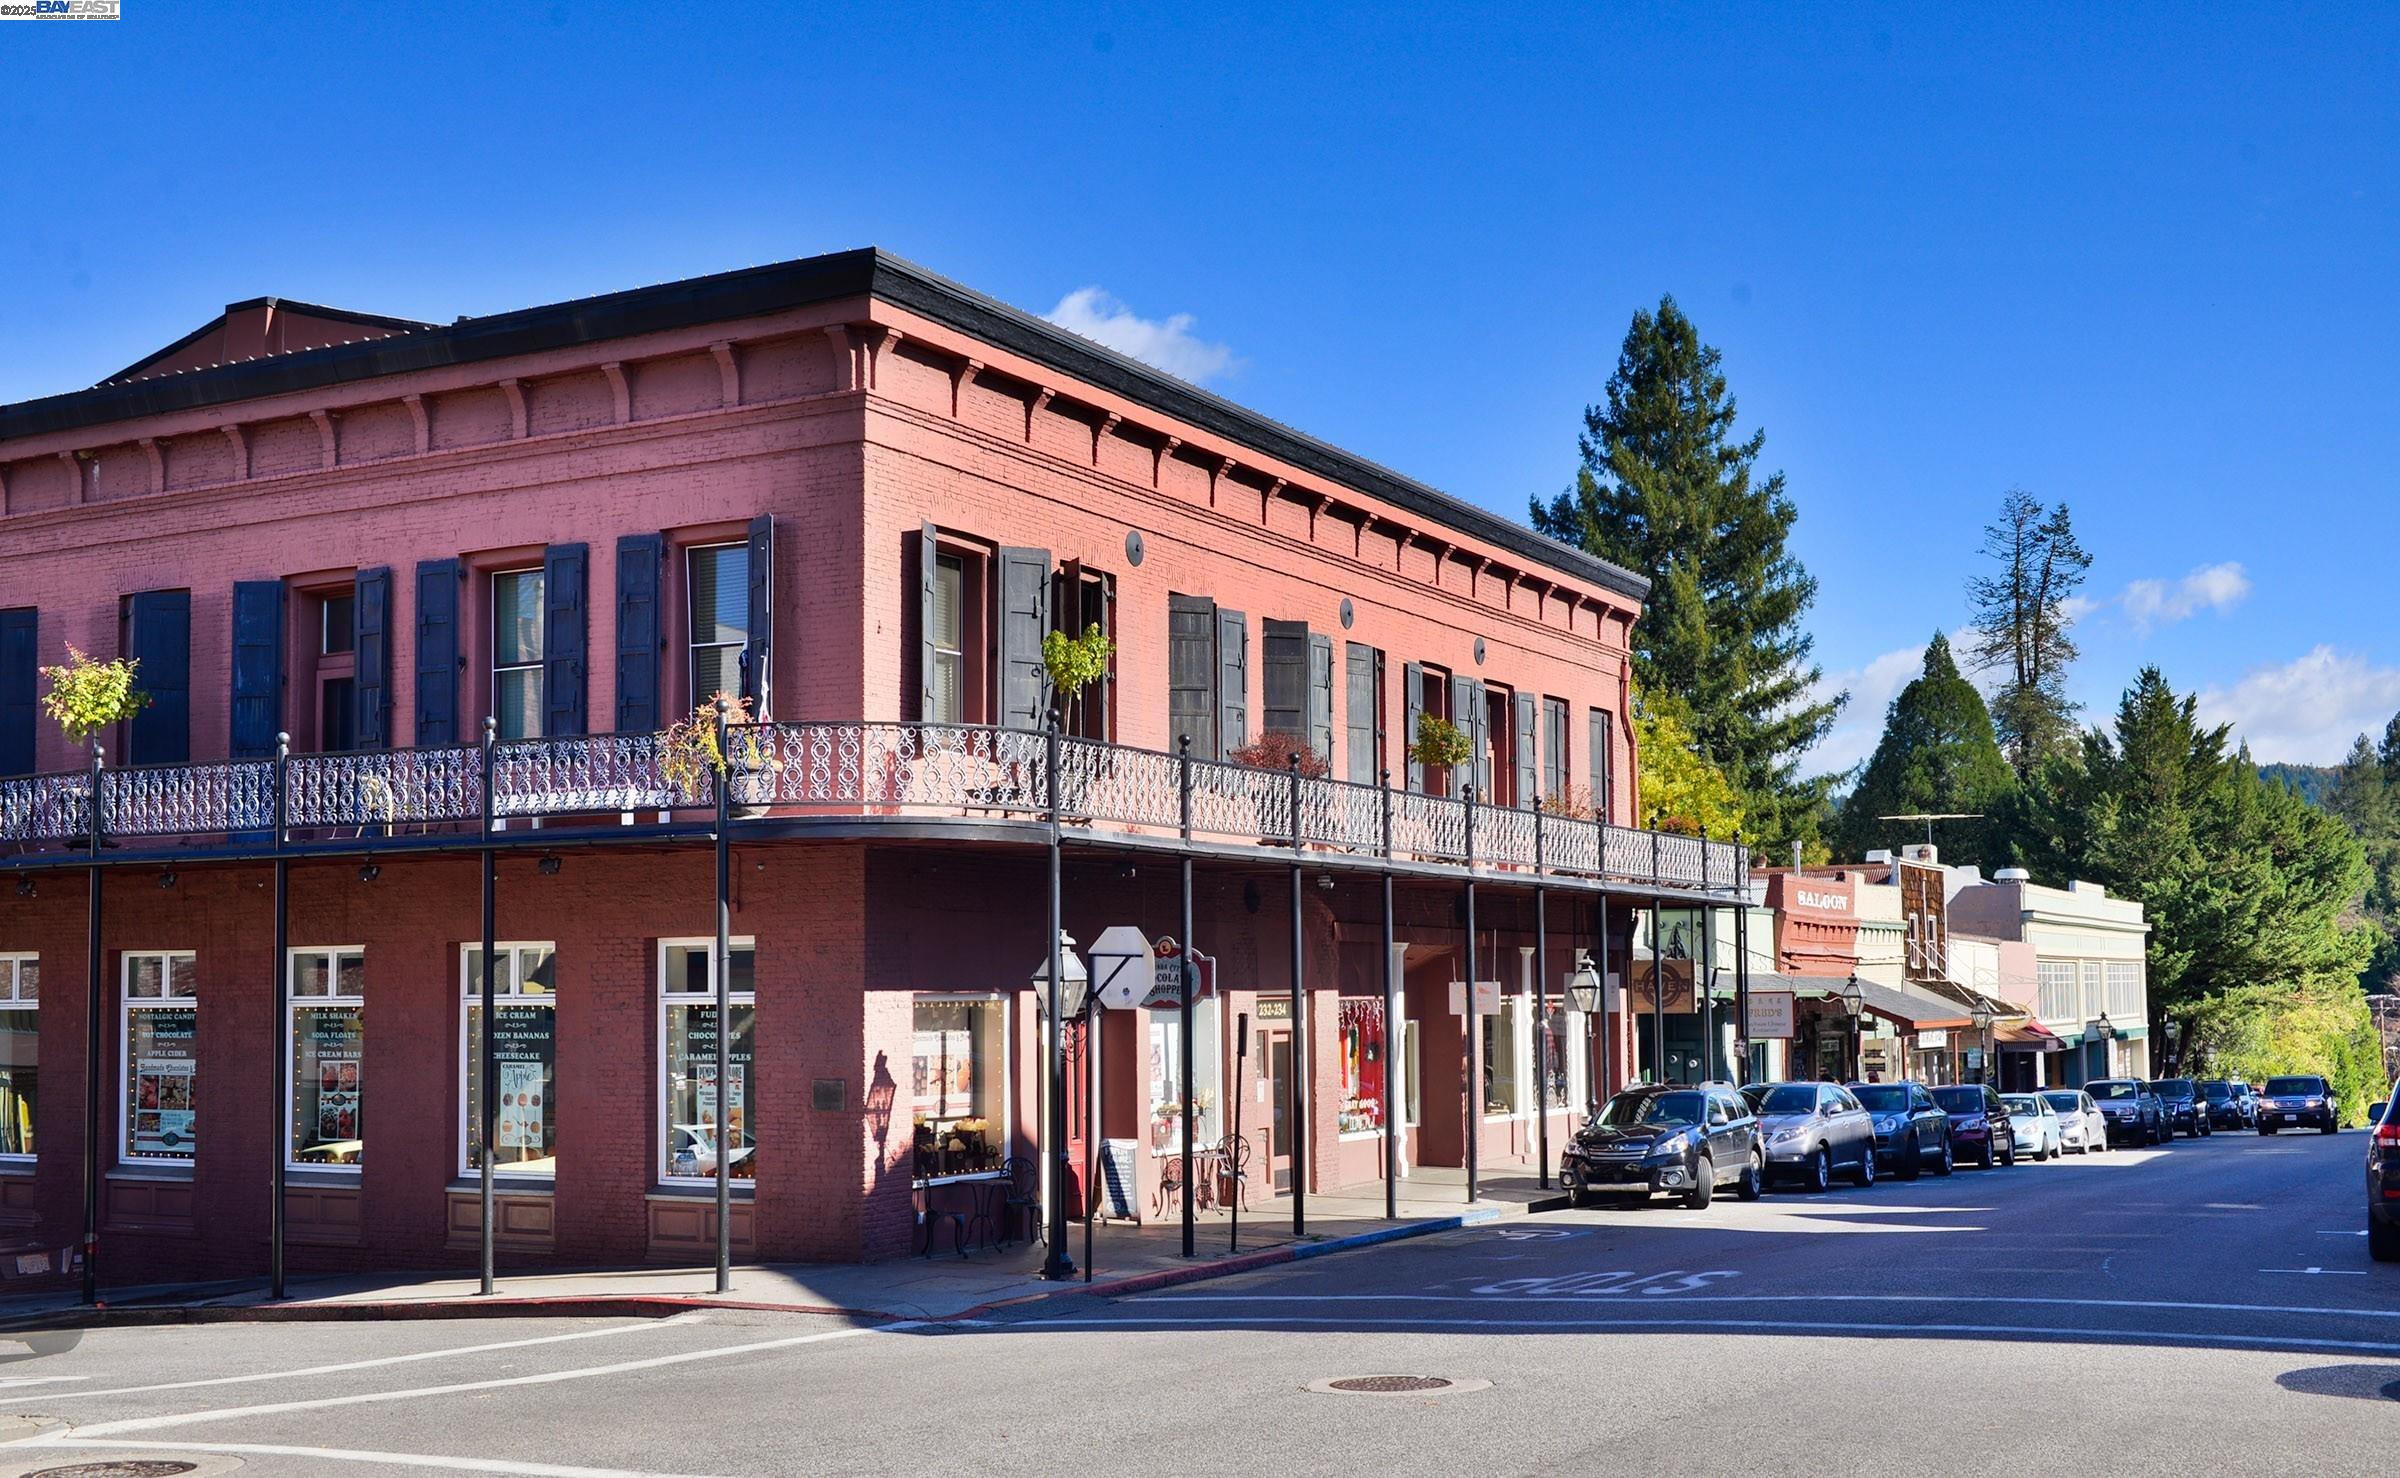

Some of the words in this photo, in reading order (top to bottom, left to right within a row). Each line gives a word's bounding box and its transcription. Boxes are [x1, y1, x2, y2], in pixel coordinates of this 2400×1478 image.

[1797, 890, 1848, 911] SALOON
[1258, 1003, 1287, 1016] 232-234
[310, 1012, 328, 1020] MILK
[329, 1012, 357, 1020] SHAKES
[495, 1011, 509, 1020] ICE
[510, 1011, 537, 1020] CREAM
[700, 1011, 717, 1019] FUD
[155, 1031, 193, 1039] CHOCOLATE
[311, 1031, 329, 1039] SODA
[330, 1031, 356, 1039] FLOATS
[513, 1031, 550, 1040] BANANAS
[688, 1032, 741, 1040] CHOCOES
[304, 1050, 316, 1058] ICE
[317, 1050, 342, 1058] CREAM
[343, 1050, 362, 1058] BARS
[728, 1053, 752, 1062] PPLES
